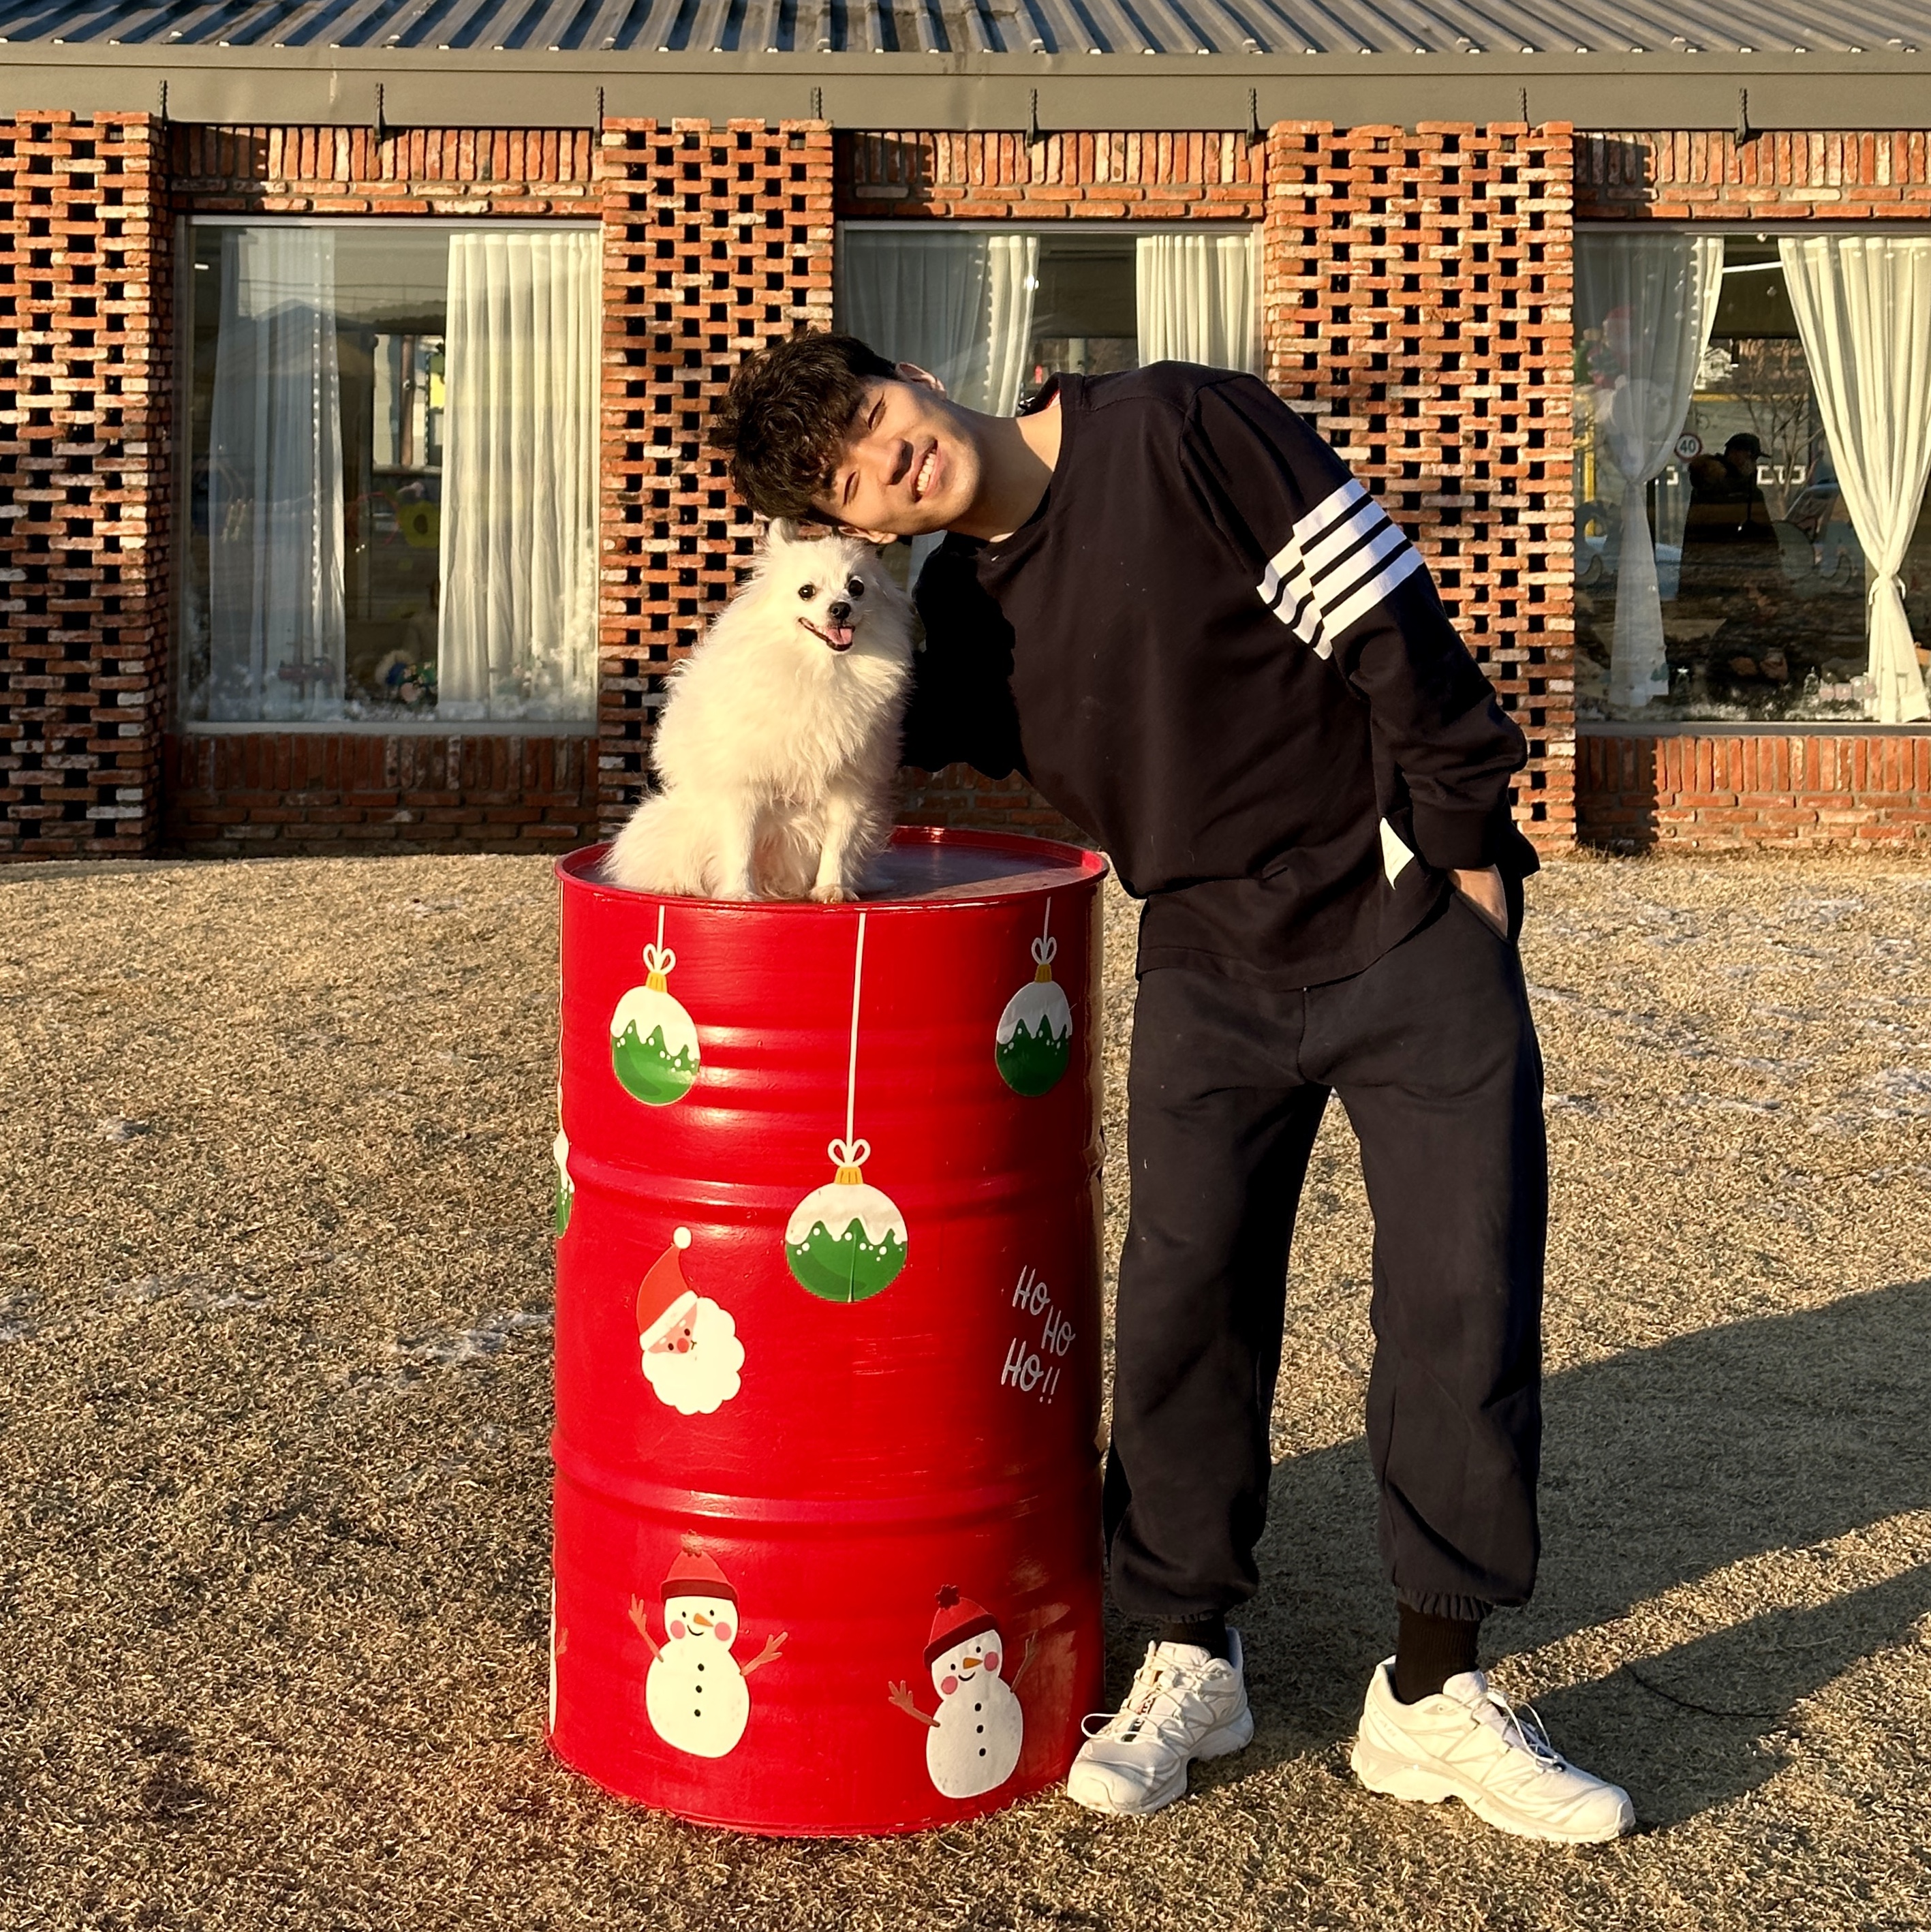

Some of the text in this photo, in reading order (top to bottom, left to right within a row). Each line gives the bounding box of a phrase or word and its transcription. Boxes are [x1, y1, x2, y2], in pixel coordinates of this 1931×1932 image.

[1680, 440, 1697, 453] 40
[1012, 1264, 1051, 1315] HO
[1040, 1305, 1076, 1356] HO
[1000, 1337, 1061, 1405] HO!!
